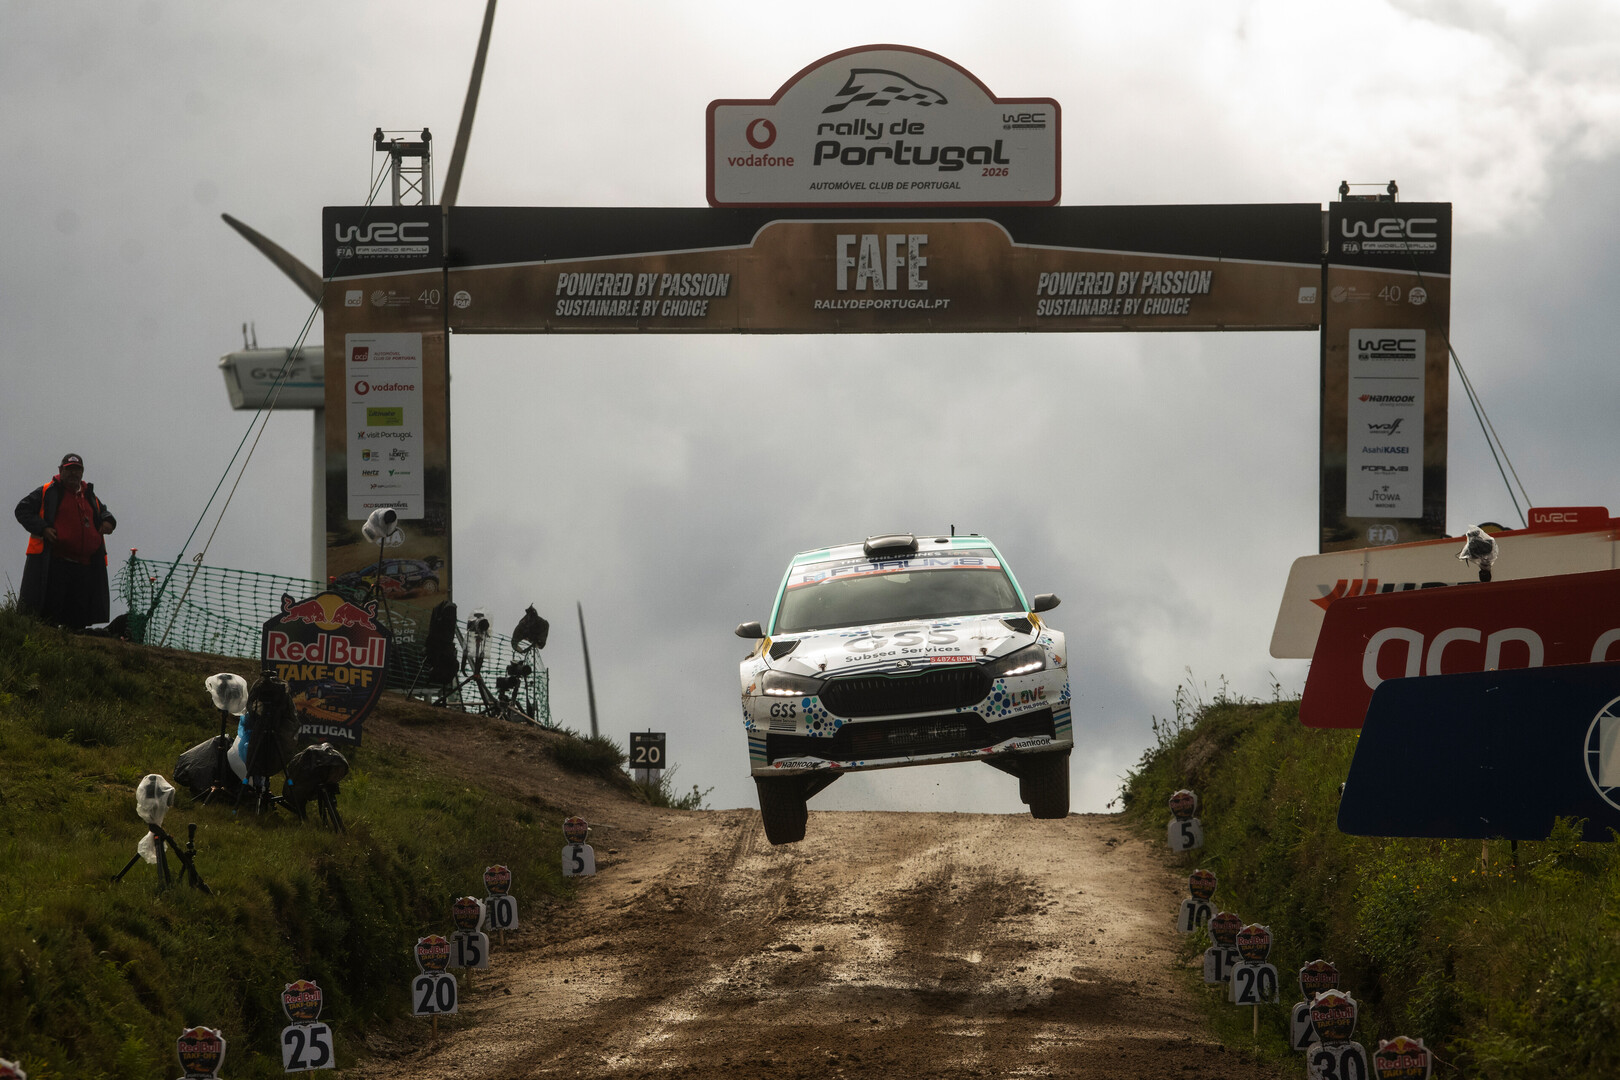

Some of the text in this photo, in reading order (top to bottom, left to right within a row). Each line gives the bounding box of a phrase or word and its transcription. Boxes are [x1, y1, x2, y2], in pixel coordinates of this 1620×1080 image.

[817, 118, 925, 140] rally de
[728, 154, 794, 167] vodafone
[813, 139, 1010, 171] Portugal
[981, 168, 1009, 177] 2026
[809, 180, 961, 190] AUTOMÓVEL CLUB DE PORTUGAL
[335, 222, 429, 242] WRC
[1342, 218, 1438, 238] WRC
[836, 233, 929, 291] FAFE
[556, 272, 731, 297] POWERED BY PASSION
[1037, 270, 1212, 296] POWERED BY PASSION
[418, 289, 441, 305] 40
[1378, 285, 1402, 302] 40
[555, 299, 708, 317] SUSTAINABLE BY CHOICE
[814, 299, 950, 310] RALLYDEPORTUGAL.PT
[1037, 298, 1190, 316] SUSTAINABLE BY CHOICE
[1358, 339, 1416, 351] WRC
[372, 383, 415, 391] vodafone
[381, 431, 413, 441] Portugal
[1362, 446, 1409, 454] AsahiKASEI
[1534, 512, 1578, 523] WRC
[1368, 527, 1397, 542] FIA
[831, 558, 984, 577] FORUM8
[266, 630, 387, 668] Red Bull
[843, 629, 959, 653] GSS
[845, 646, 960, 662] Subsea Services
[276, 664, 373, 688] TAKE-OFF
[1011, 685, 1046, 707] LOVE
[770, 703, 796, 718] GSS
[636, 746, 660, 763] 20
[1181, 822, 1195, 849] 5
[572, 848, 584, 873] 5
[487, 899, 512, 928] 10
[1187, 903, 1211, 931] 10
[418, 945, 450, 955] Red Bull
[455, 935, 480, 966] 15
[1237, 967, 1276, 1003] 20
[285, 991, 320, 1003] Red Bull
[416, 977, 455, 1013] 20
[1312, 1010, 1333, 1021] Red
[1297, 1008, 1319, 1047] 2
[179, 1041, 221, 1052] Red Bull
[285, 1027, 330, 1069] 25
[1313, 1048, 1366, 1080] 30
[1376, 1053, 1427, 1069] Red Bull
